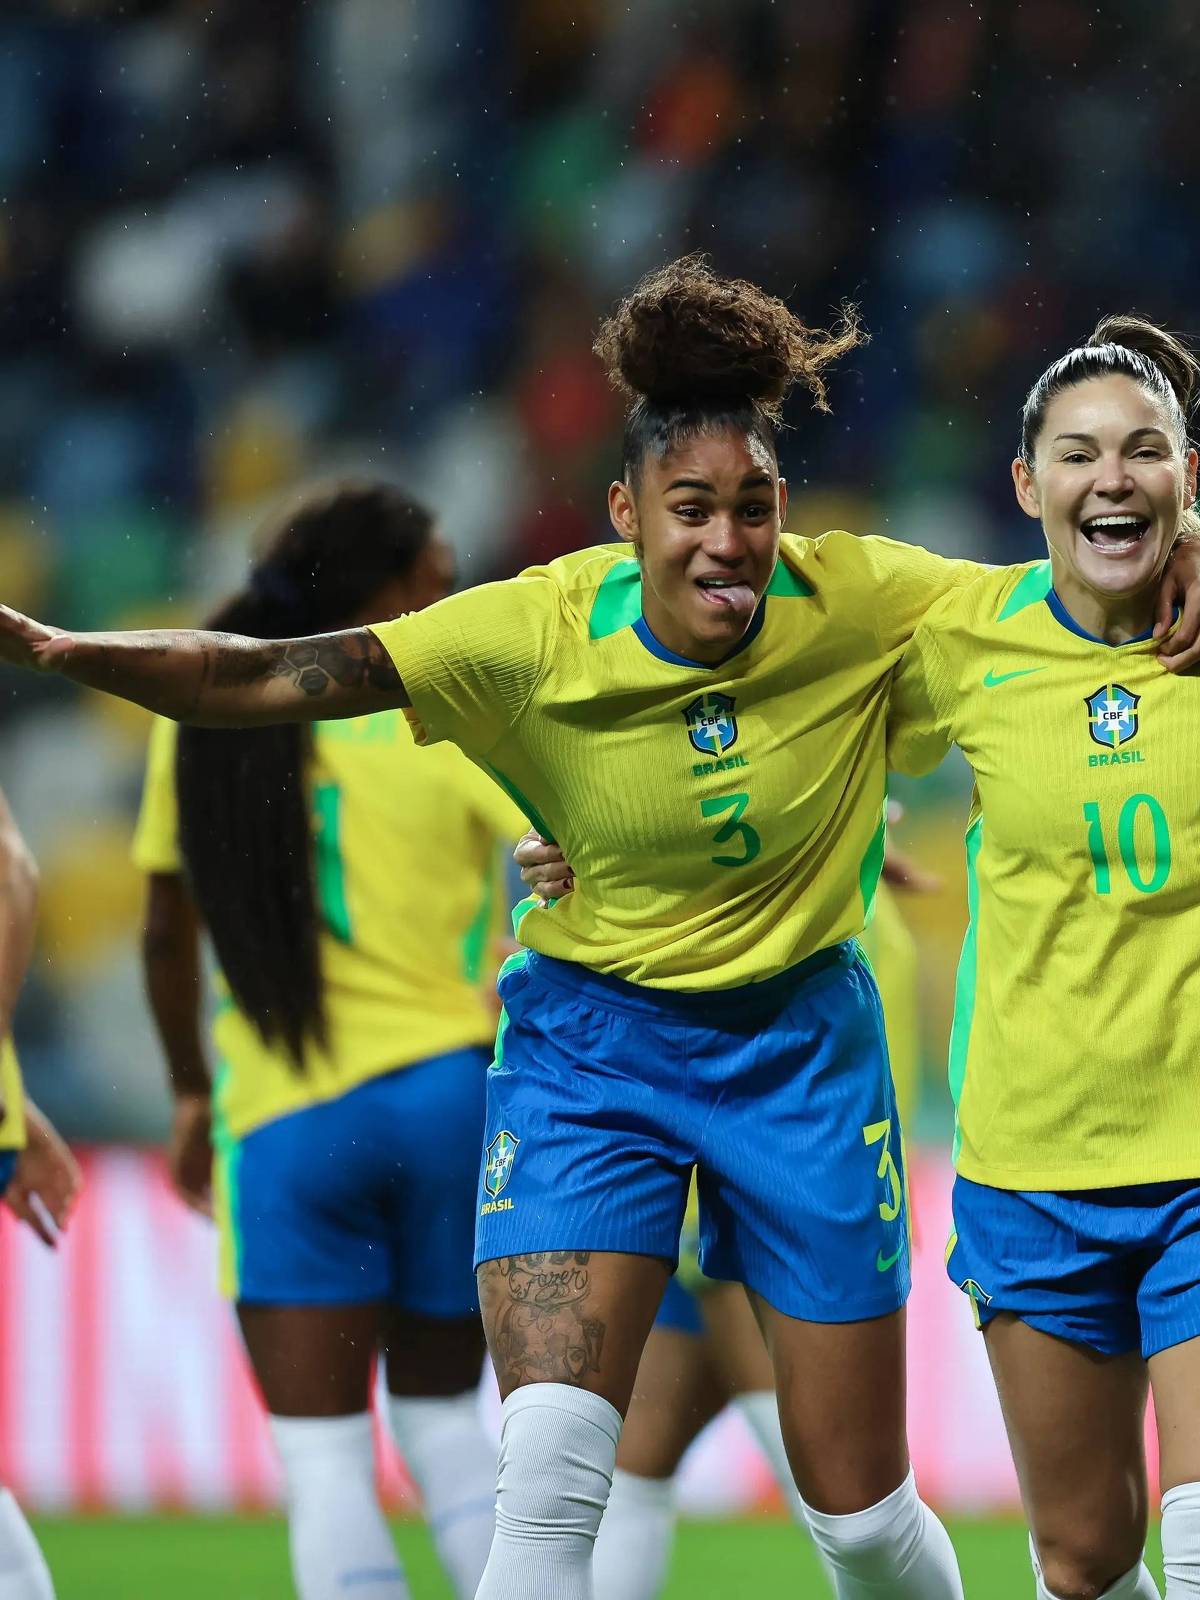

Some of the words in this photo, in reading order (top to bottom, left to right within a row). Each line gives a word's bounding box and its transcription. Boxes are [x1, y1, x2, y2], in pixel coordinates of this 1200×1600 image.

[701, 715, 721, 727] CBF
[1102, 711, 1123, 721] CBF
[692, 756, 749, 776] BRASIL
[1088, 751, 1145, 768] BRASIL
[700, 792, 761, 867] 3
[1083, 793, 1172, 894] 10
[494, 1158, 507, 1168] CBF
[863, 1119, 901, 1221] 3
[481, 1198, 514, 1216] BRASIL
